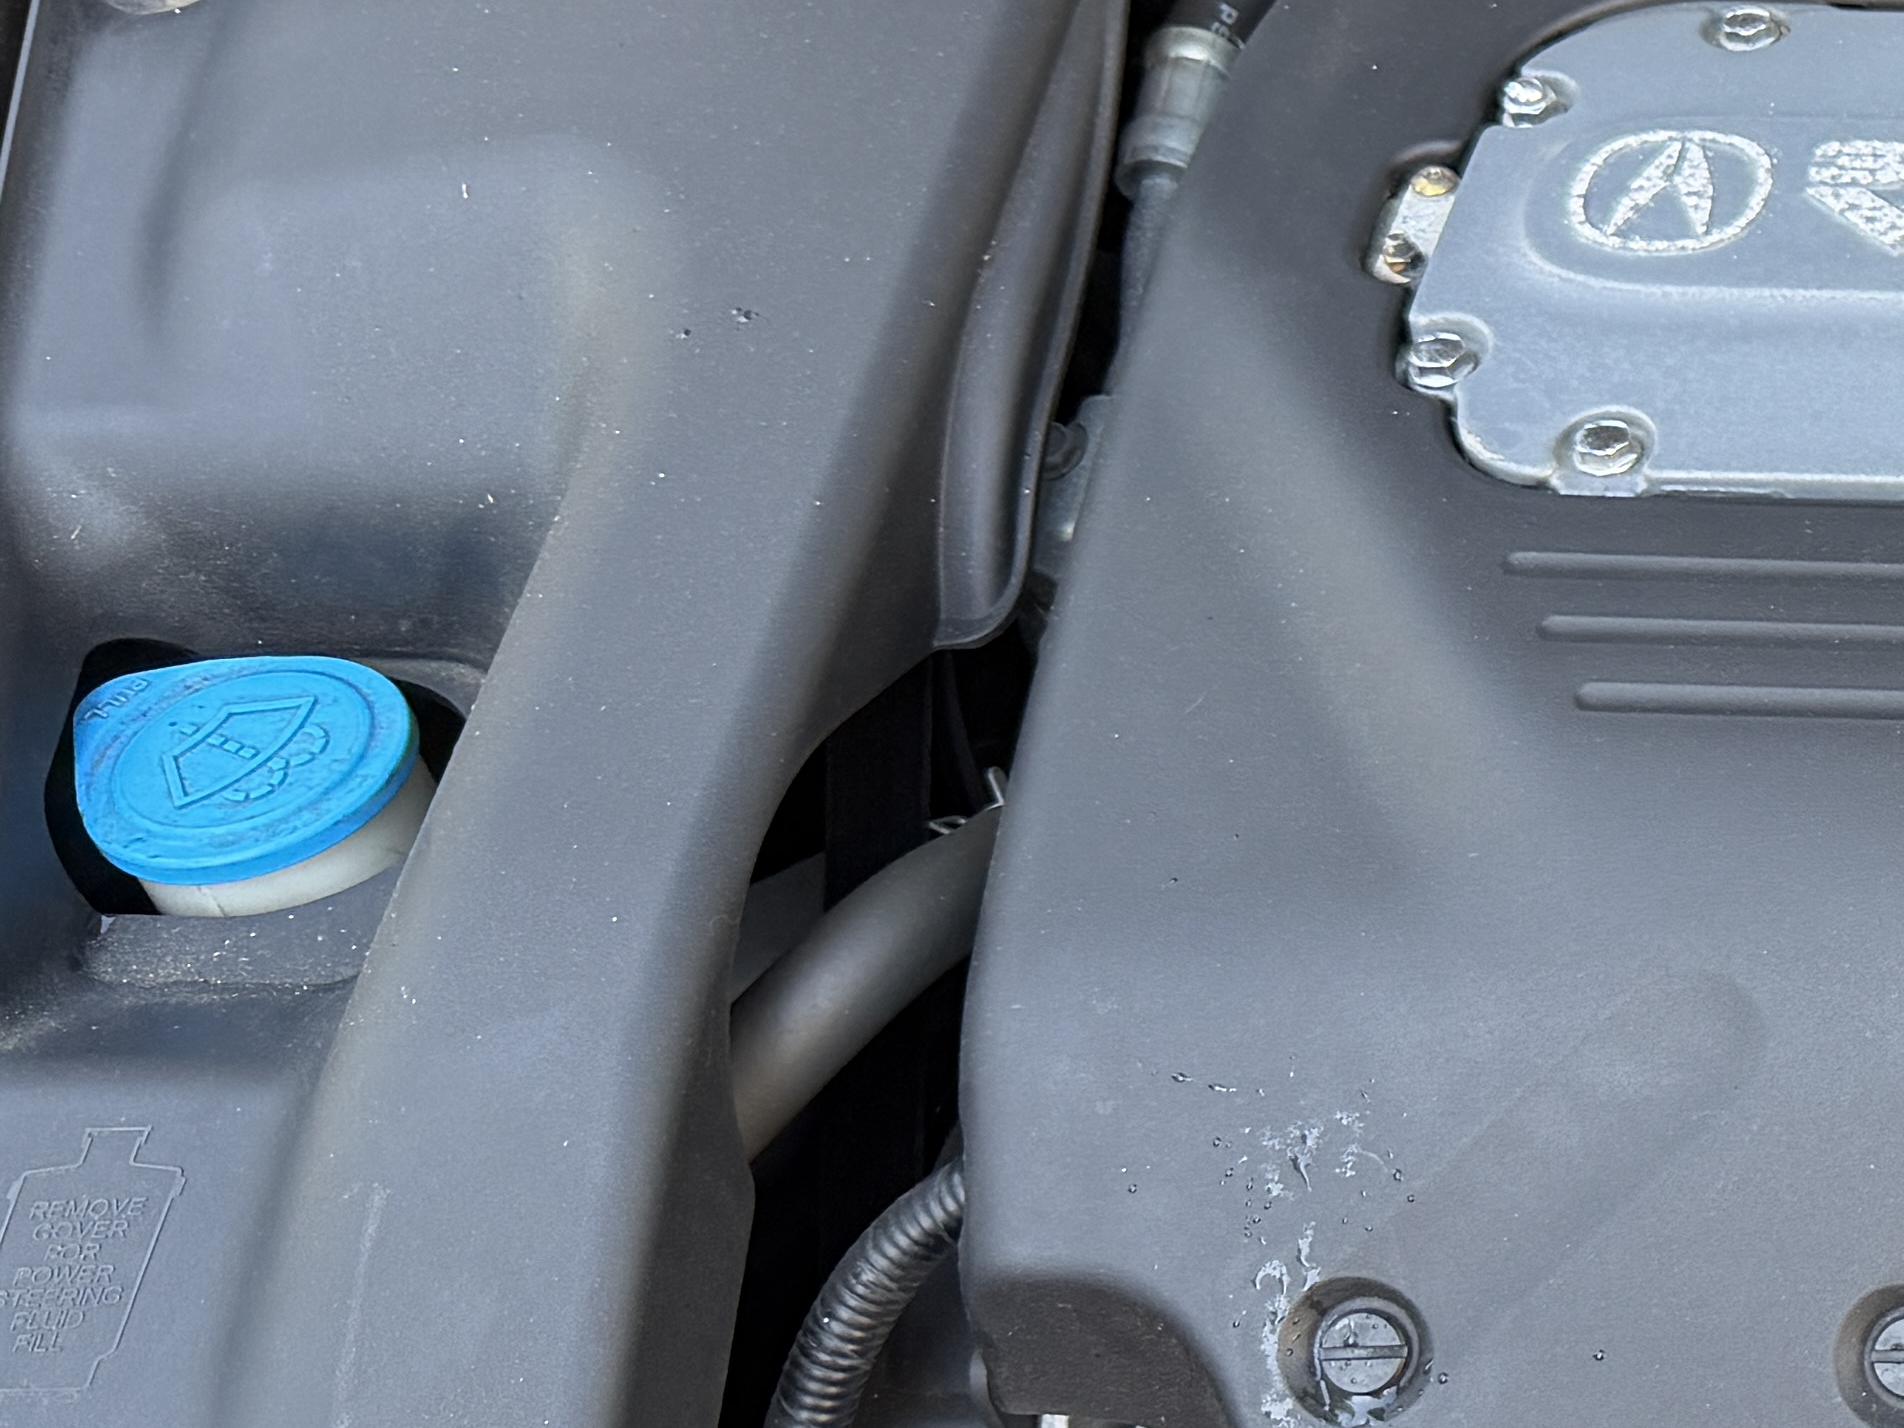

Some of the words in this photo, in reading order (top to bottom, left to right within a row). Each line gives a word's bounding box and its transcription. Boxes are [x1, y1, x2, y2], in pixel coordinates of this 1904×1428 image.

[84, 677, 149, 720] PULL
[29, 1196, 148, 1220] REMOVE
[32, 1220, 130, 1241] COVER
[44, 1243, 102, 1261] FOR
[13, 1265, 116, 1287] POWER
[10, 1309, 86, 1331] FLUID
[12, 1331, 63, 1353] FILL
